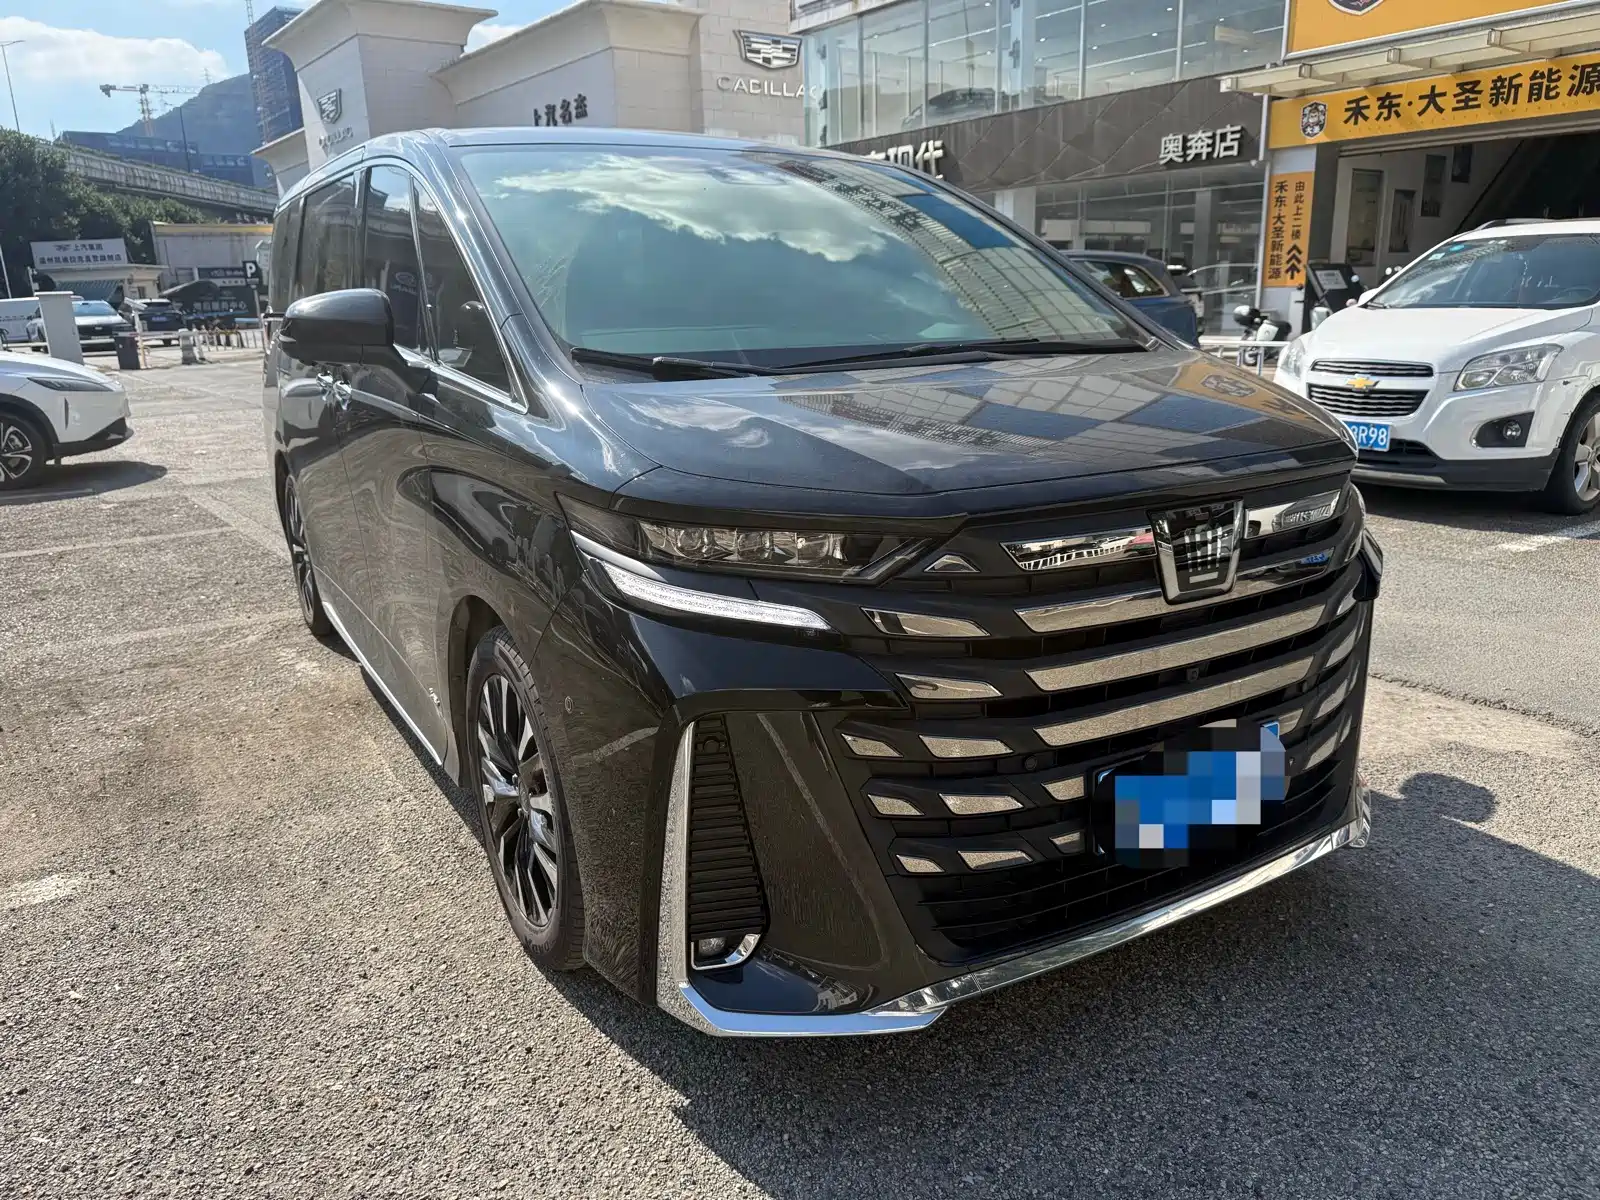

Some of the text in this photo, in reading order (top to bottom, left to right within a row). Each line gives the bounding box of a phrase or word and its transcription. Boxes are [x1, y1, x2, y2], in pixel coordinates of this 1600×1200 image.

[1159, 124, 1242, 165] 奥奔店
[1291, 181, 1305, 240] 由此上二楼
[246, 262, 257, 278] P
